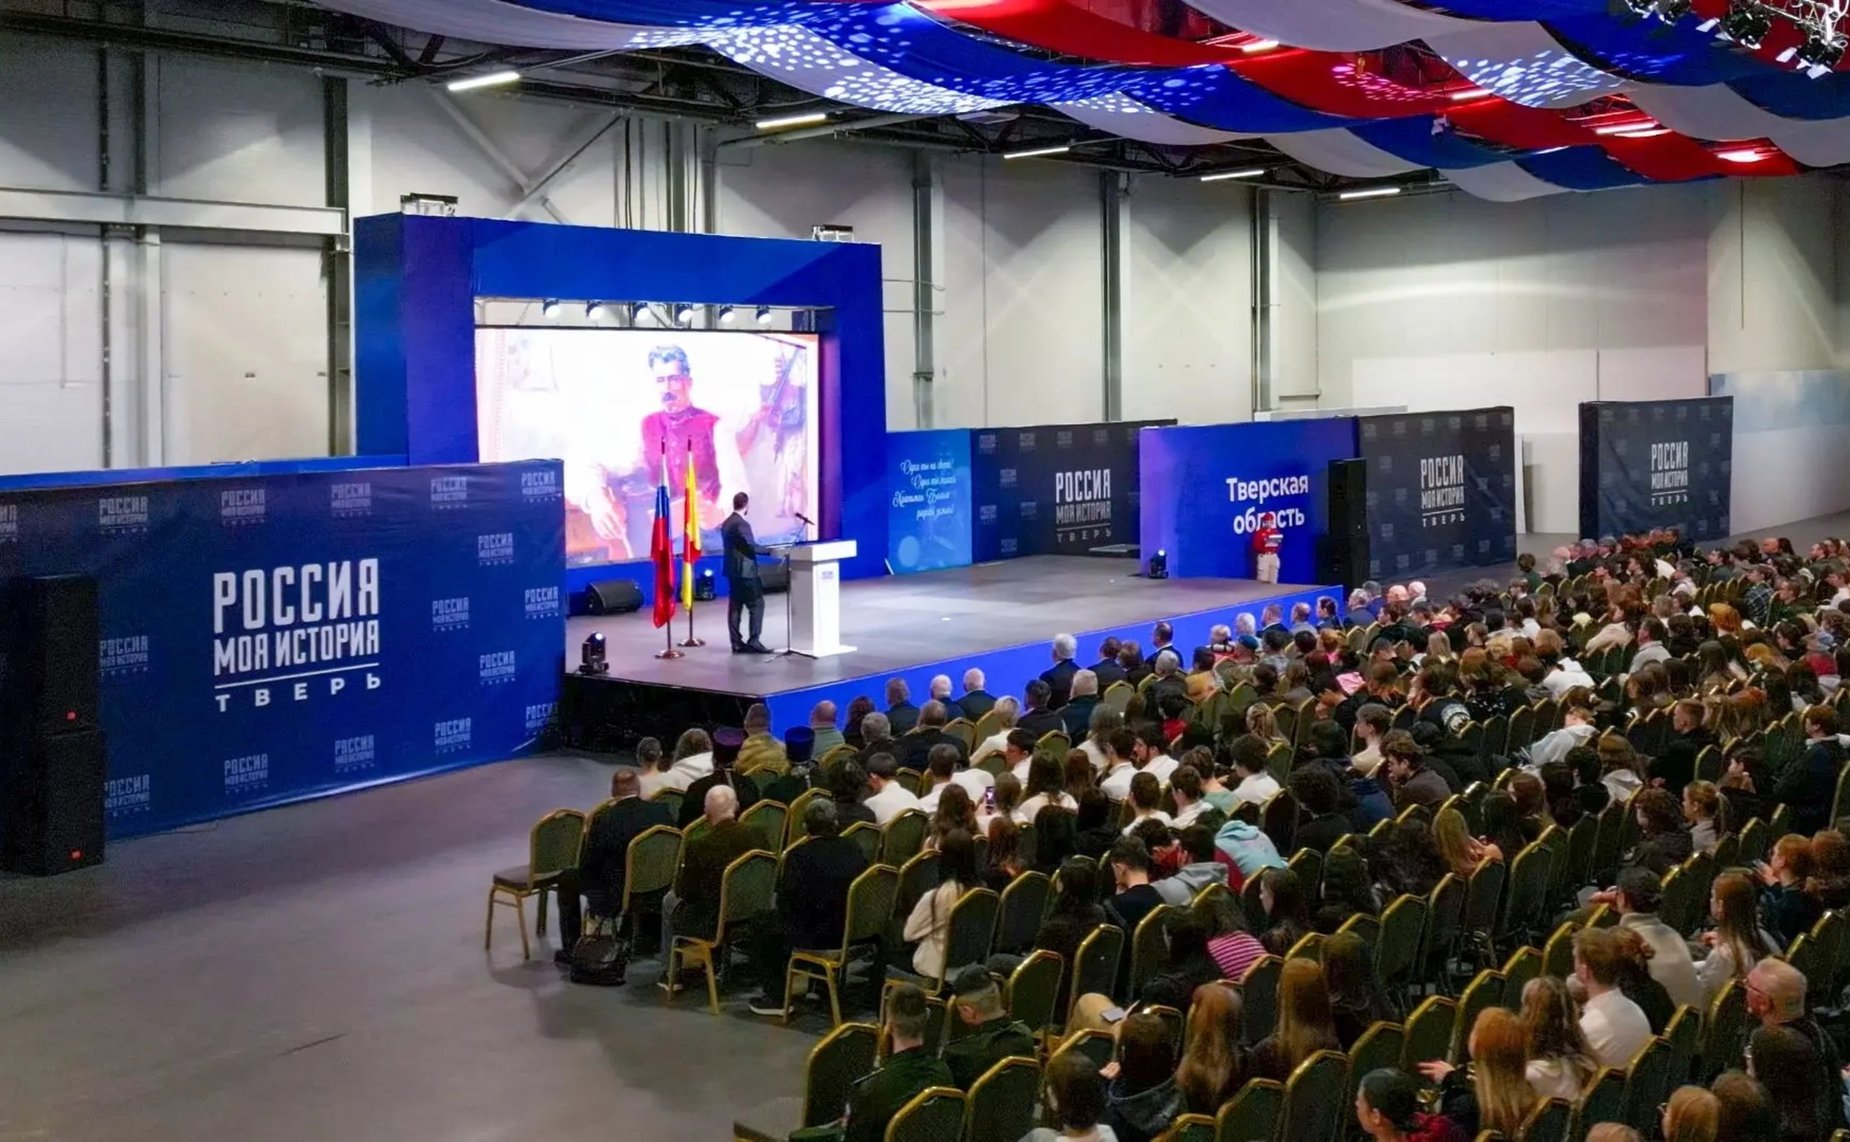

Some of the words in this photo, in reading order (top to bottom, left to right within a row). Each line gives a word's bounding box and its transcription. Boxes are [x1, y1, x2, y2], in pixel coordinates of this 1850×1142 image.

[1421, 455, 1464, 489] РОССИЯ
[1652, 441, 1688, 471] РОССИЯ
[1056, 469, 1110, 503] РОССИЯ
[1226, 476, 1308, 504] Тверская
[1056, 504, 1074, 524] МОЯ
[1076, 501, 1111, 522] ИСТОРИЯ
[1056, 528, 1112, 542] ТВЕРЬ
[214, 558, 378, 634] РОССИЯ
[214, 634, 268, 676] МОЯ
[276, 620, 378, 668] ИСТОРИЯ
[215, 673, 380, 712] ТВЕРЬ
